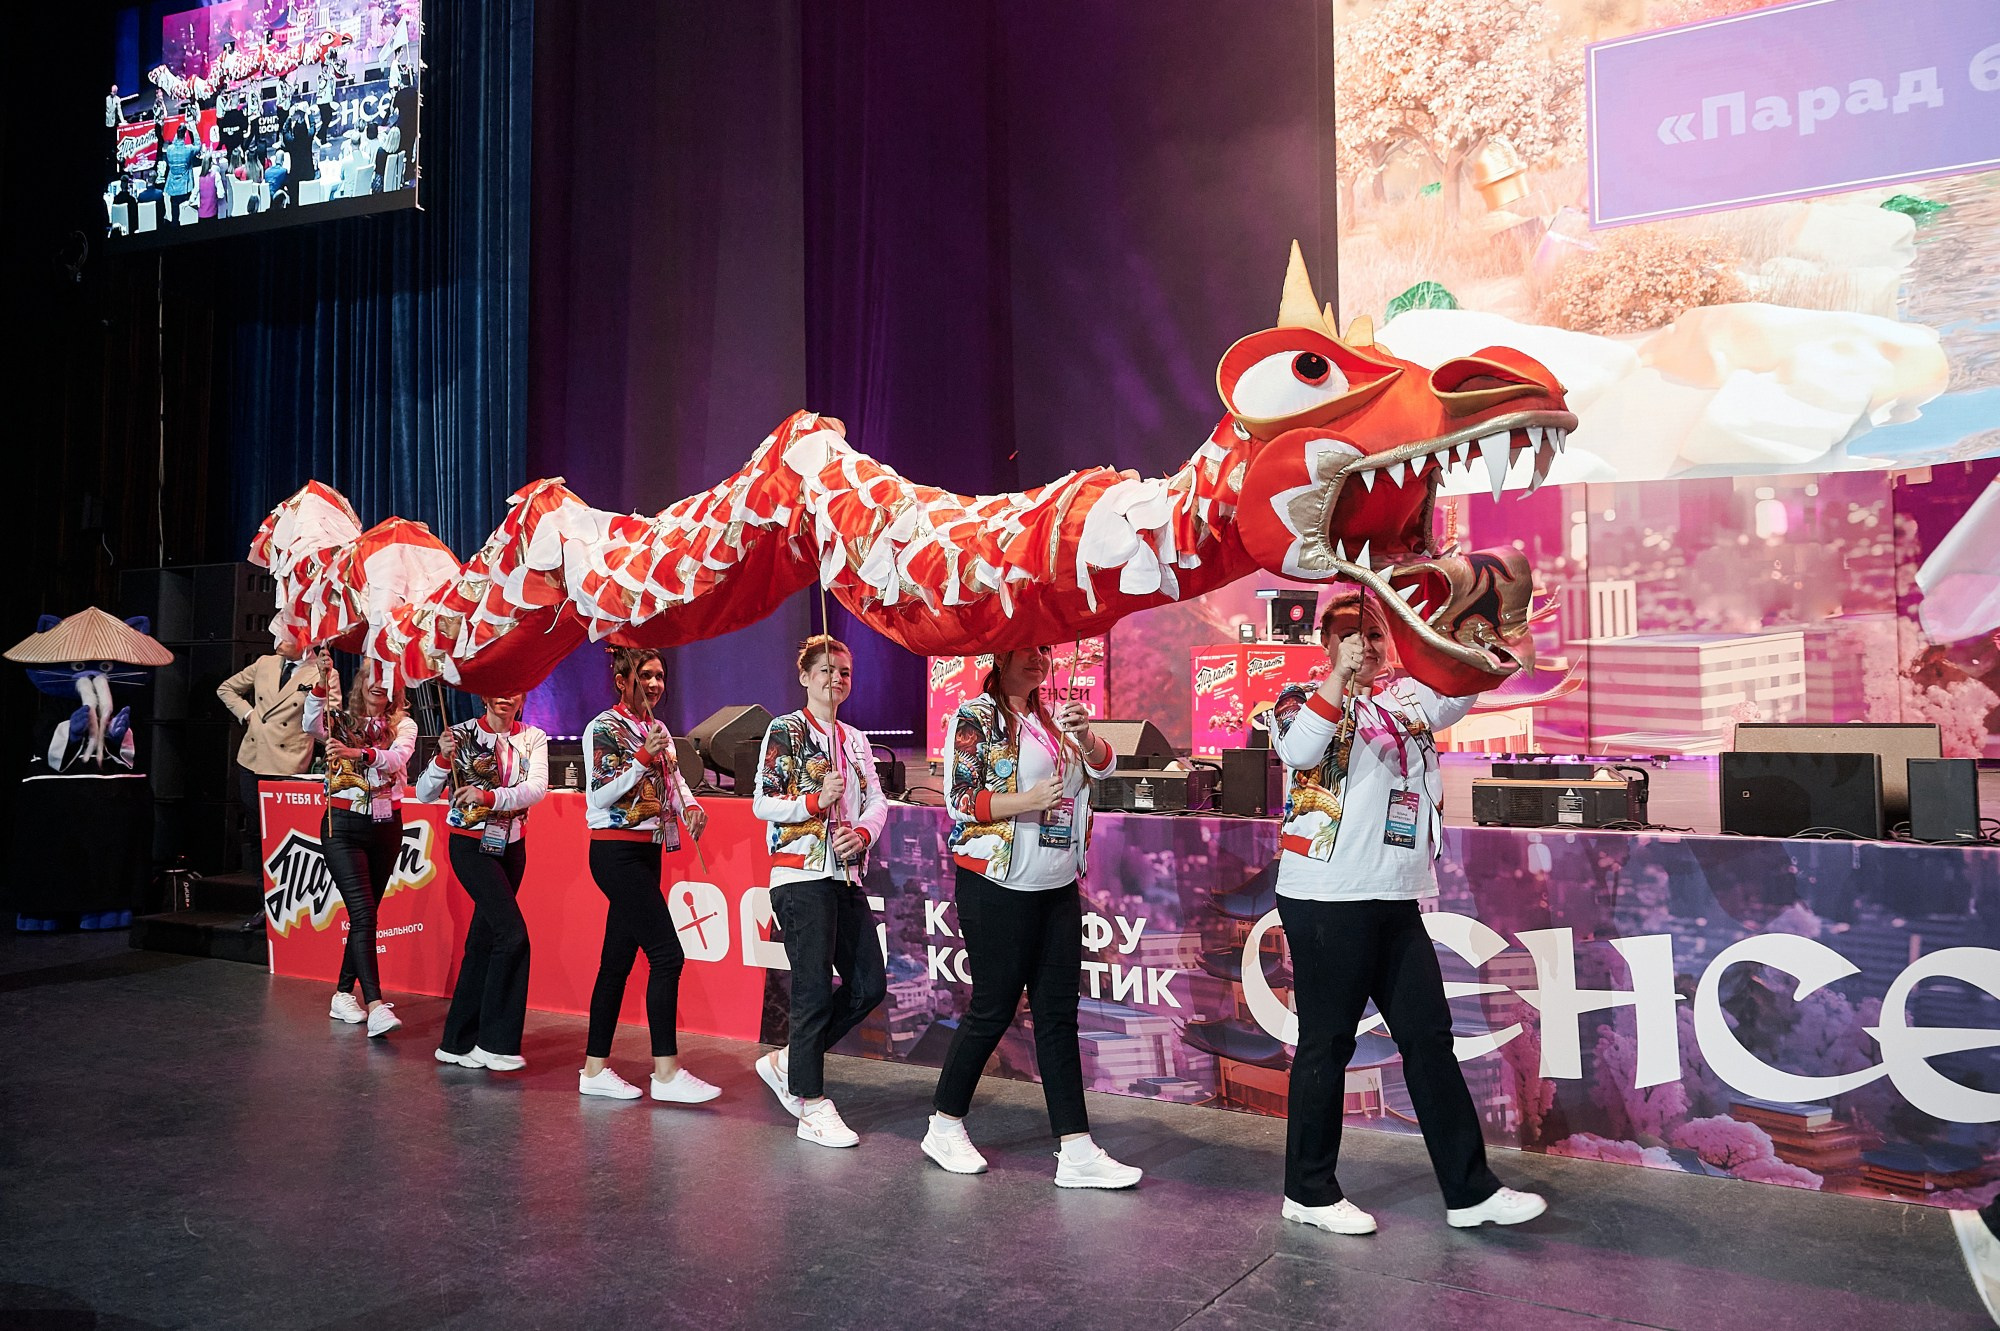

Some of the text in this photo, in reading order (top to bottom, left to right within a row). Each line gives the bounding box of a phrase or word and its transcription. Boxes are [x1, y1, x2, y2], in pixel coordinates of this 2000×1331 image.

[1656, 67, 1944, 145] «Парад
[276, 792, 283, 804] У
[285, 792, 311, 805] ТЕБЯ
[314, 793, 322, 805] К
